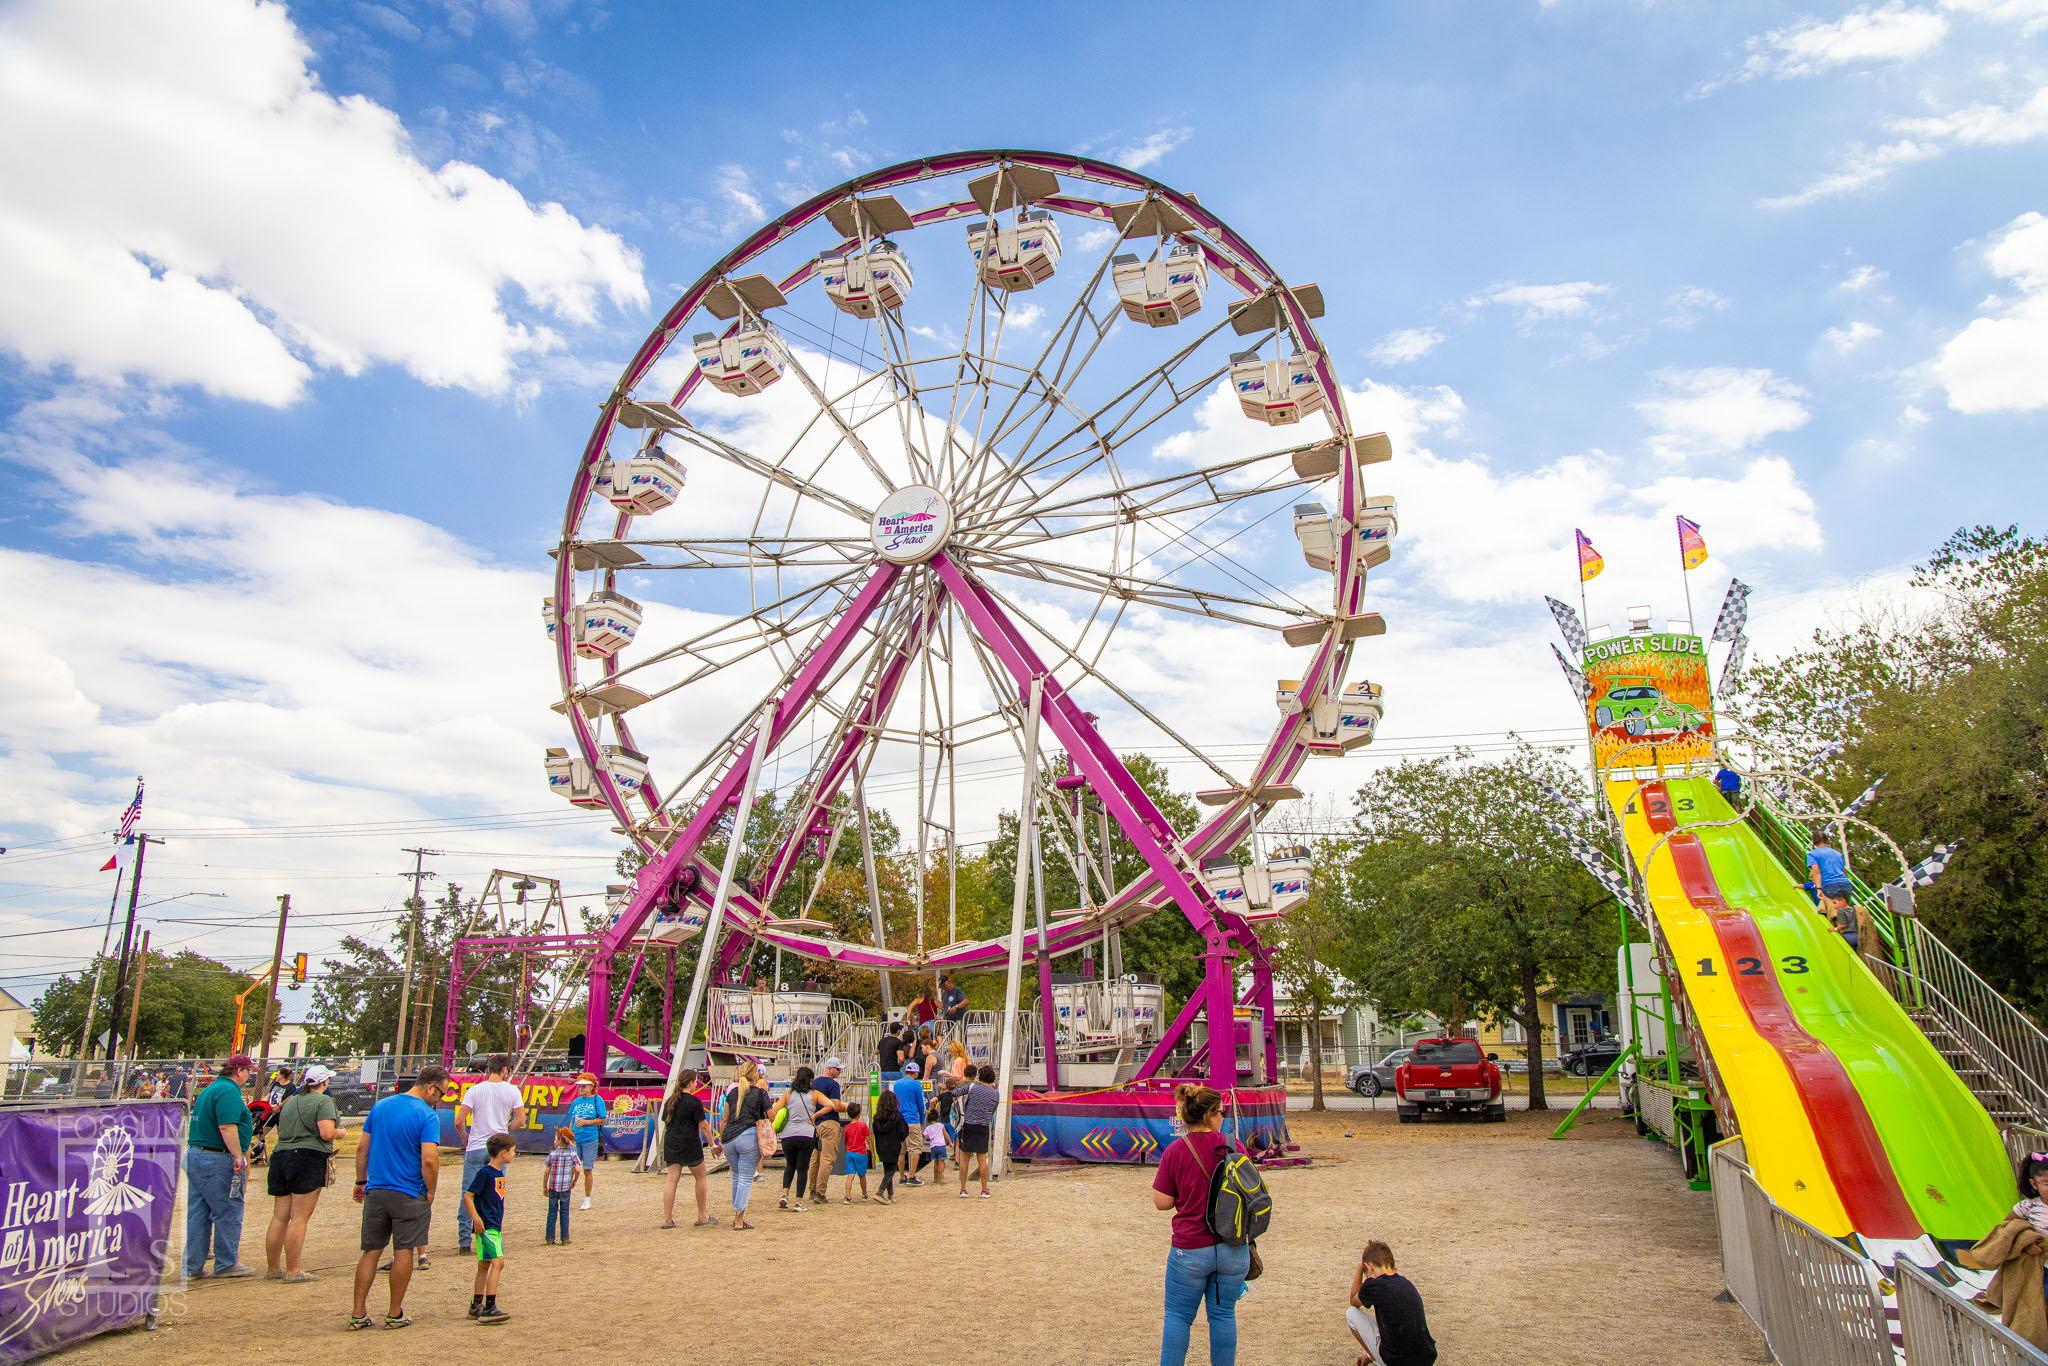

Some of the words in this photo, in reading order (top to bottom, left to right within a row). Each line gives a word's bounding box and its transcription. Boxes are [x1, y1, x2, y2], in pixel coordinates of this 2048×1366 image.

[1173, 245, 1189, 255] 15
[639, 450, 647, 458] 4
[878, 516, 905, 526] Heart
[893, 523, 934, 535] America
[1584, 637, 1646, 663] POWER
[1649, 636, 1701, 655] SLIDE
[1624, 802, 1638, 815] 1
[1651, 801, 1667, 813] 2
[1677, 798, 1694, 811] 3
[1696, 958, 1717, 976] 1
[1736, 957, 1765, 975] 2
[1781, 956, 1809, 974] 3
[1120, 973, 1138, 983] 10
[780, 982, 790, 992] 8
[1, 1178, 79, 1229] Heart
[13, 1218, 123, 1275] America
